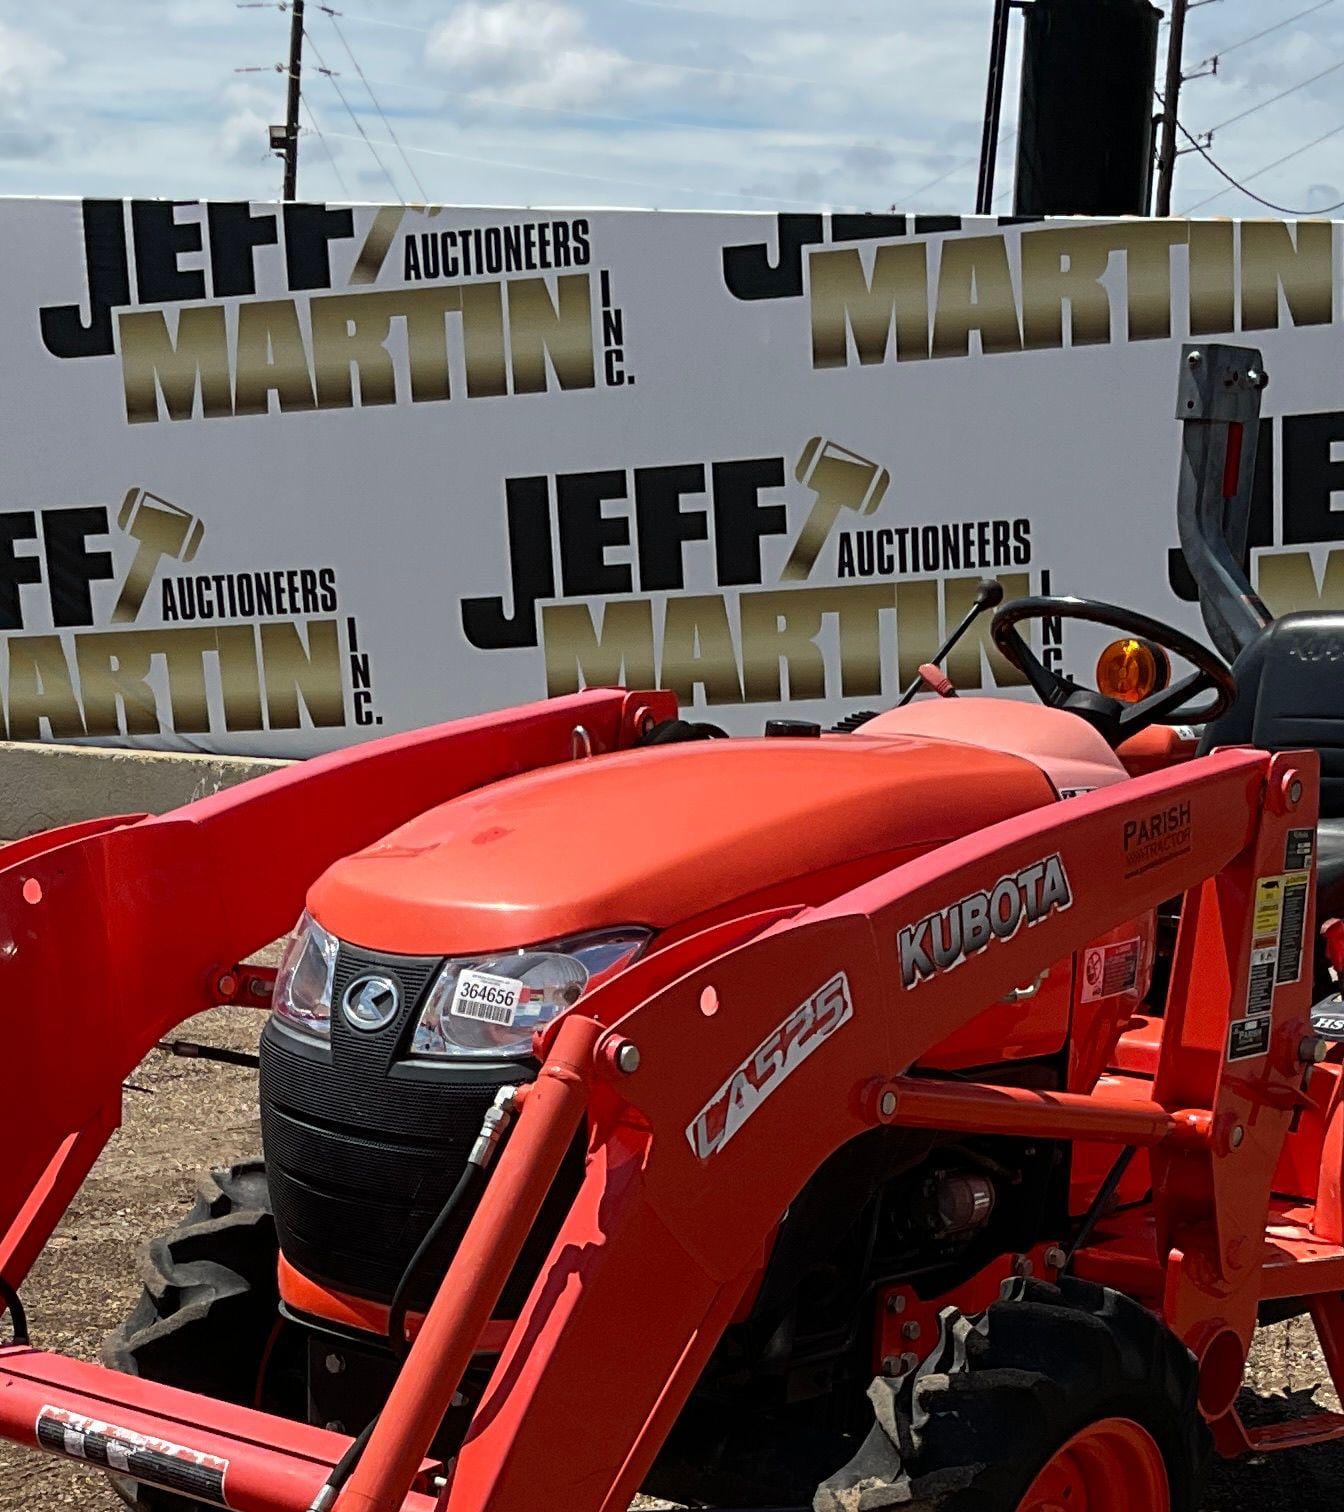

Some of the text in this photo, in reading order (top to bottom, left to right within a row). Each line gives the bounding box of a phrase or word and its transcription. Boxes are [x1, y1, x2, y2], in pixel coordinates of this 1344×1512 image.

[404, 219, 591, 281] AUCTIONEERS
[809, 219, 1333, 370] MARTIN
[118, 273, 596, 425] MARTIN
[601, 270, 635, 387] INC.
[161, 569, 337, 622] AUCTIONEERS
[460, 457, 788, 650] JEFF
[837, 519, 1031, 579] AUCTIONEERS
[347, 617, 383, 727] INC.
[542, 572, 1032, 706] MARTIN
[1123, 800, 1192, 851] PARISH
[898, 853, 1071, 988] KUBOTA
[460, 982, 515, 1006] 364656
[692, 972, 852, 1158] LA525
